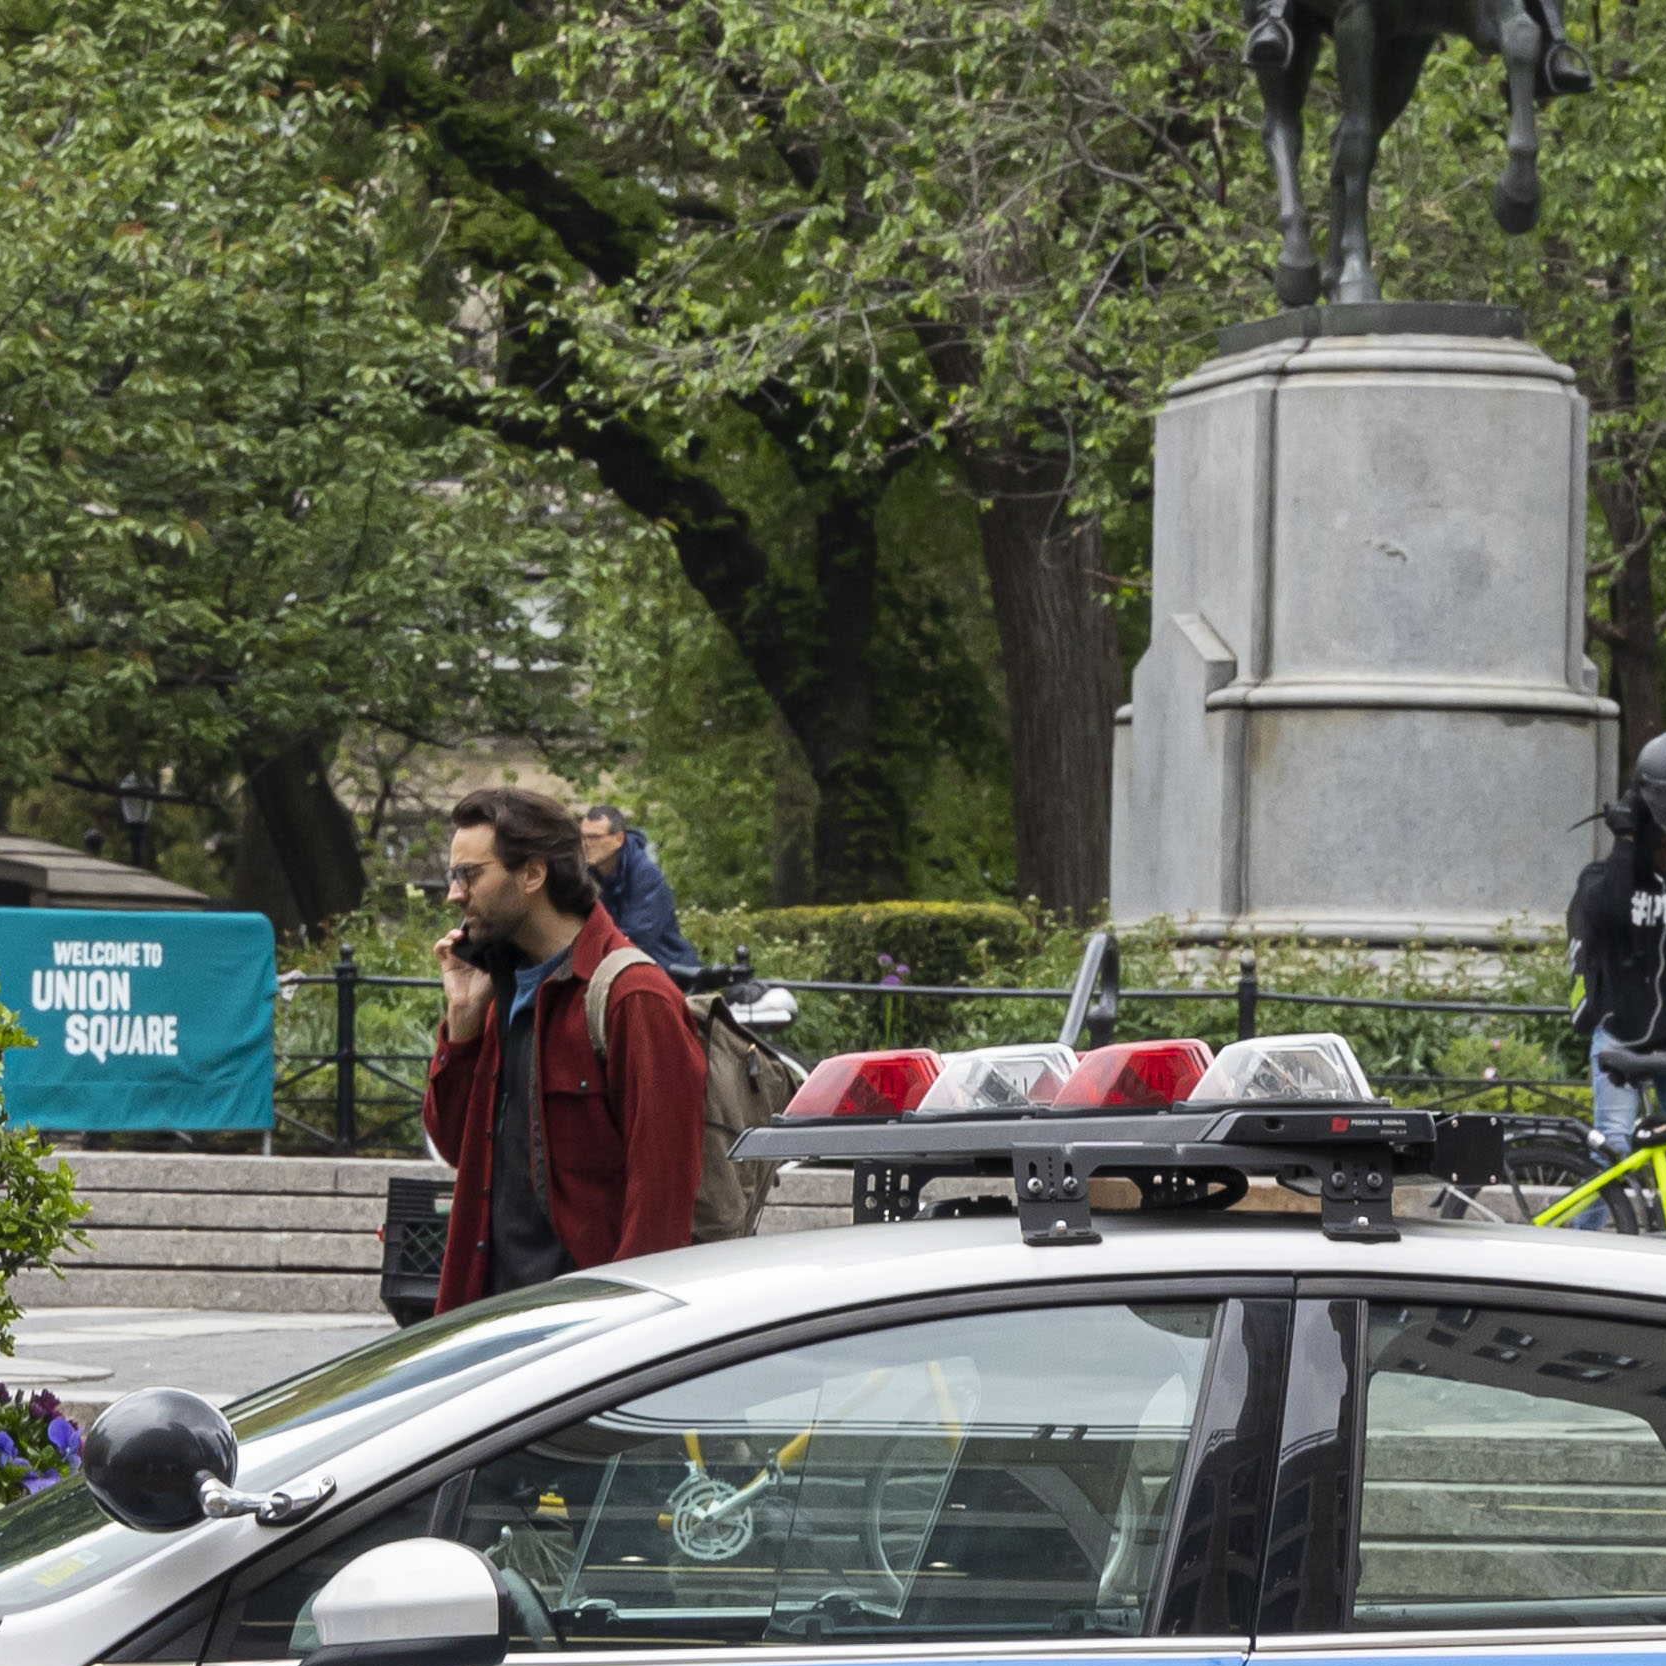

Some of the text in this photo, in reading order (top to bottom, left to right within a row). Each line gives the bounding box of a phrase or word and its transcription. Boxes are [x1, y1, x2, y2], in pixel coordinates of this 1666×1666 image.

[53, 941, 163, 968] WELCOME TO
[32, 970, 131, 1011] UNION
[65, 1014, 178, 1064] SQUARE
